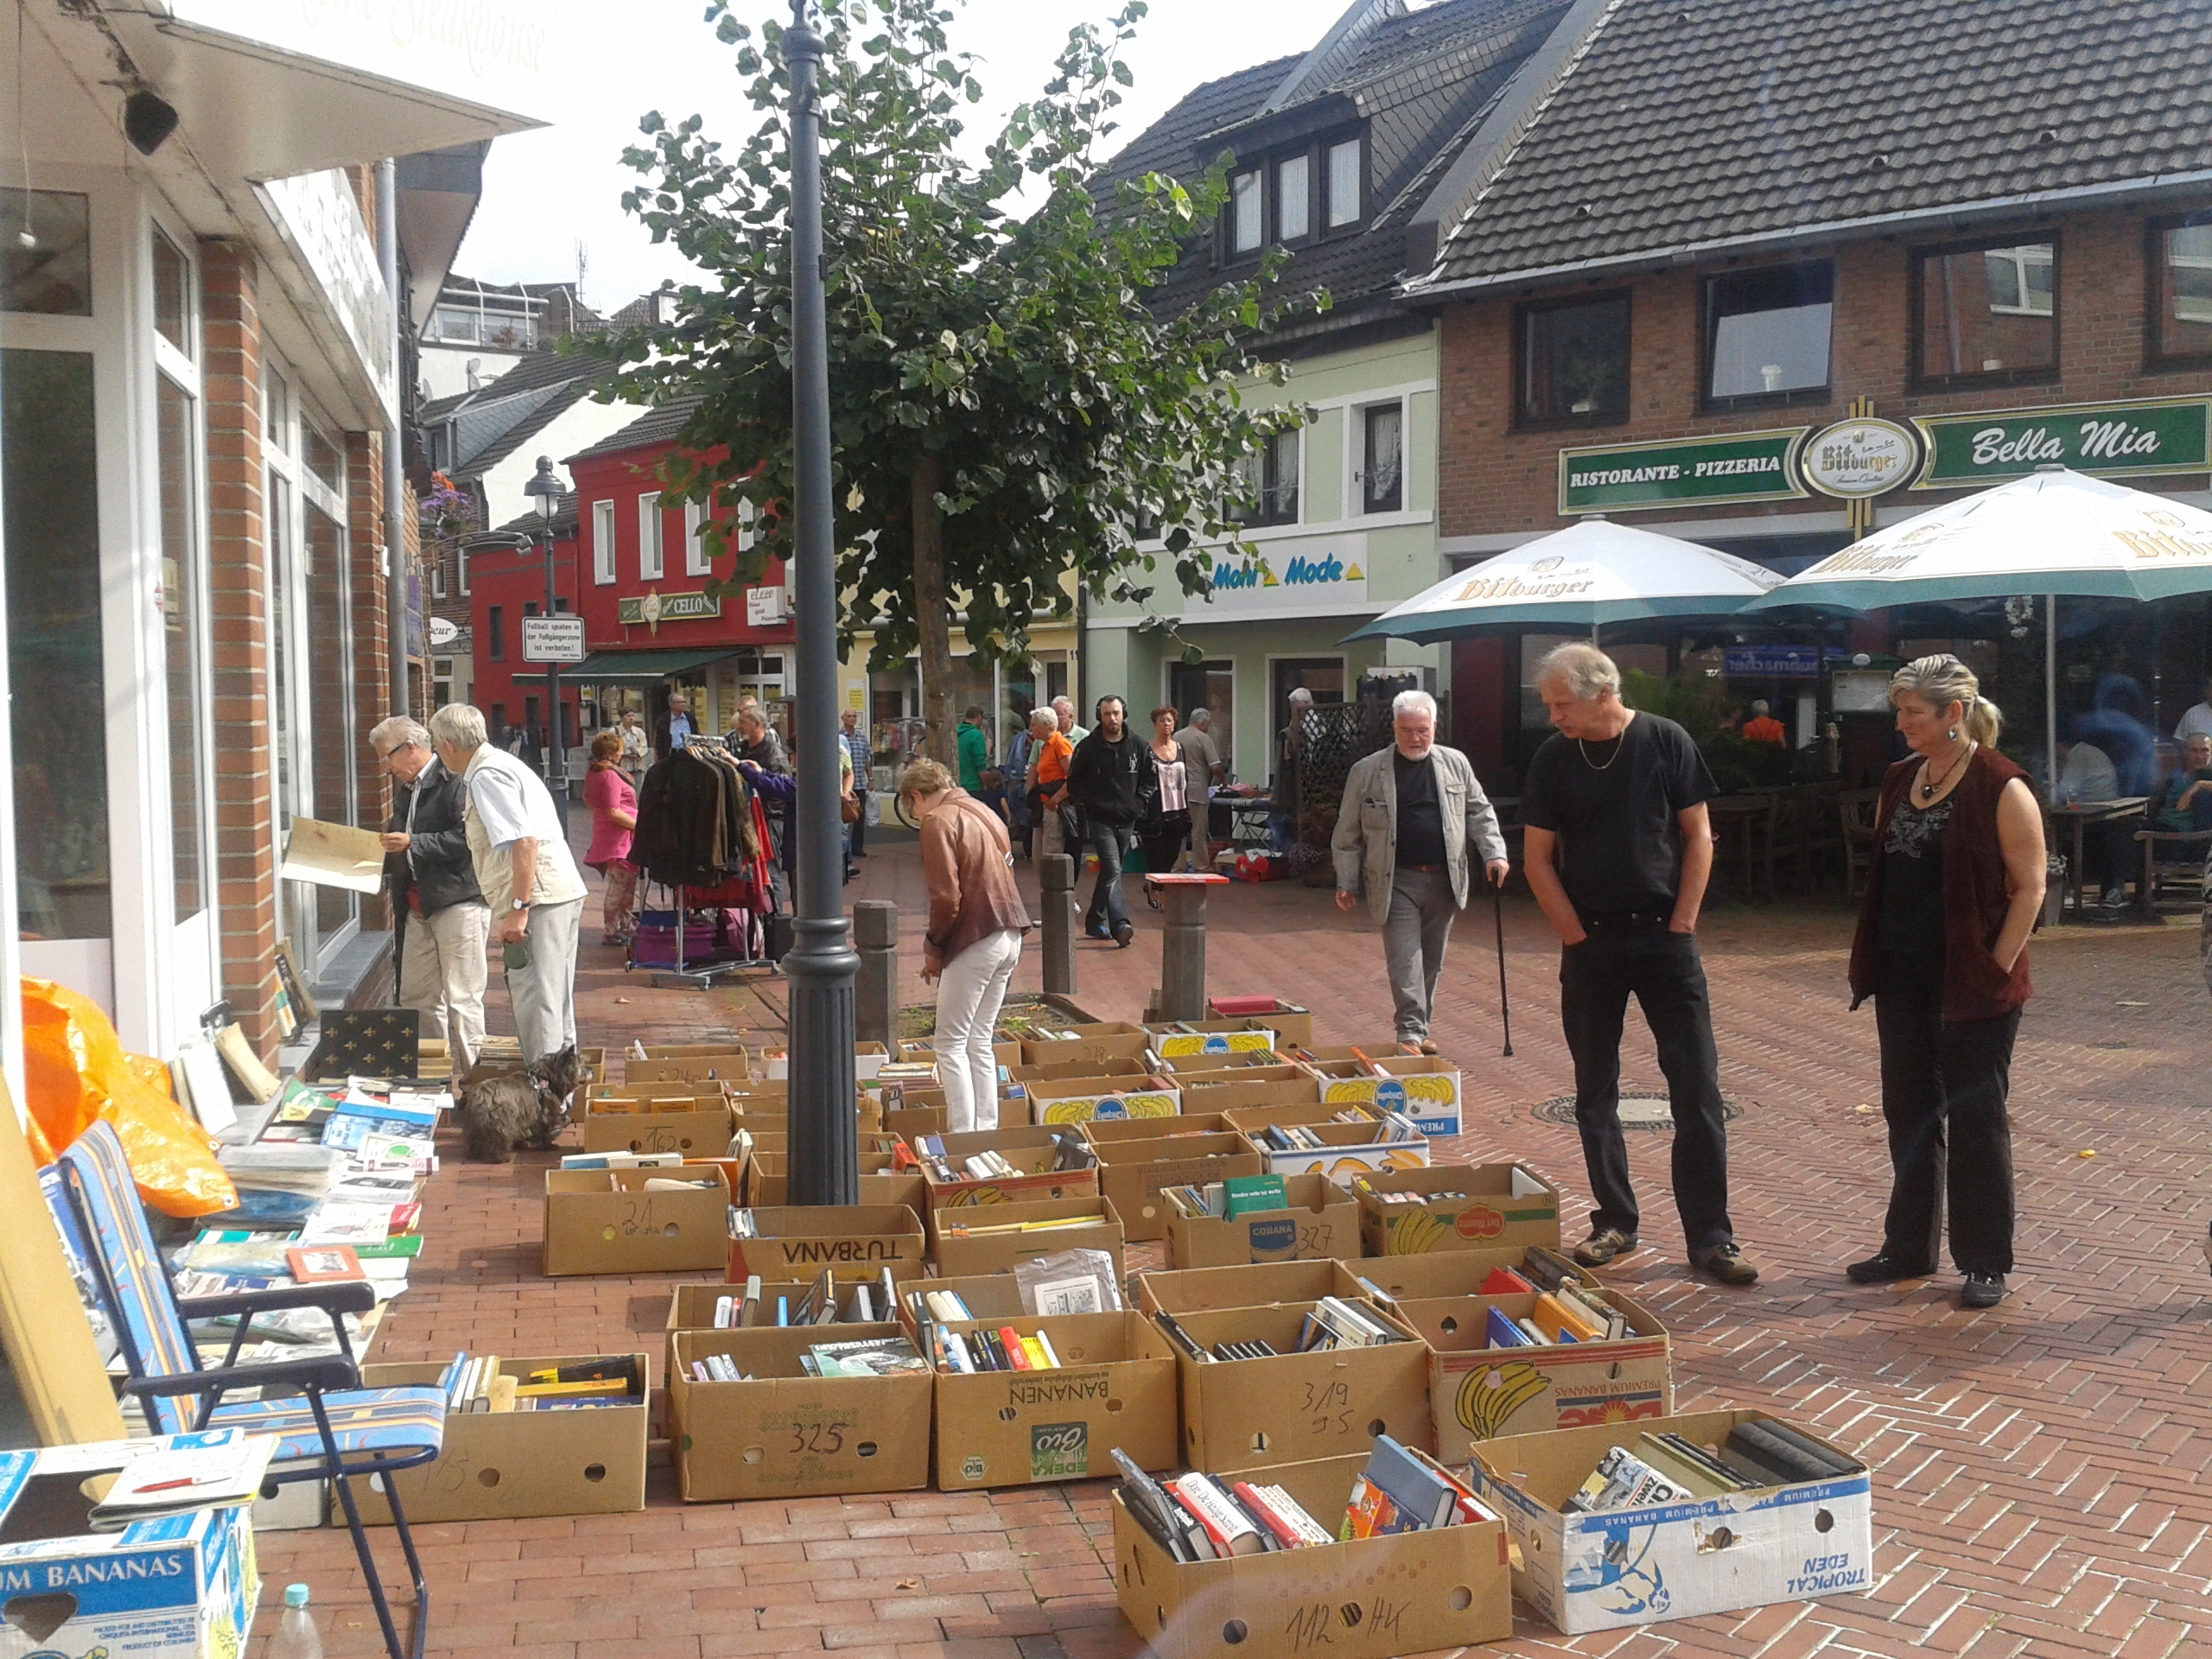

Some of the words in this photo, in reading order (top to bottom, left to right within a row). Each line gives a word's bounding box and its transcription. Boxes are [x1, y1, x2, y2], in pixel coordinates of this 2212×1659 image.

[1972, 427, 2065, 465] Bella
[2080, 421, 2161, 459] Mia
[1821, 444, 1898, 473] Bitburger
[1570, 465, 1680, 488] RISTORANTE
[1694, 456, 1781, 478] PIZZERIA
[1284, 551, 1344, 586] Mode
[1452, 575, 1595, 602] Bitburger
[674, 597, 702, 614] CELLO
[1253, 1224, 1293, 1236] COBANA
[1299, 1224, 1336, 1251] 327
[782, 1240, 903, 1263] TURBANA
[1008, 1380, 1109, 1406] BANANEN
[1554, 1384, 1606, 1396] BANANAS
[1610, 1378, 1661, 1394] PREMIUM
[790, 1422, 850, 1455] 325
[1035, 1427, 1086, 1453] Bio
[1031, 1462, 1087, 1477] EDEKA
[1783, 1487, 1831, 1503] PREMIUM
[1605, 1512, 1657, 1527] BANANAS
[1664, 1503, 1714, 1519] PREMIUM
[48, 1555, 182, 1587] BANANAS
[1802, 1553, 1849, 1575] EDEN
[1787, 1567, 1866, 1594] TROPICAL
